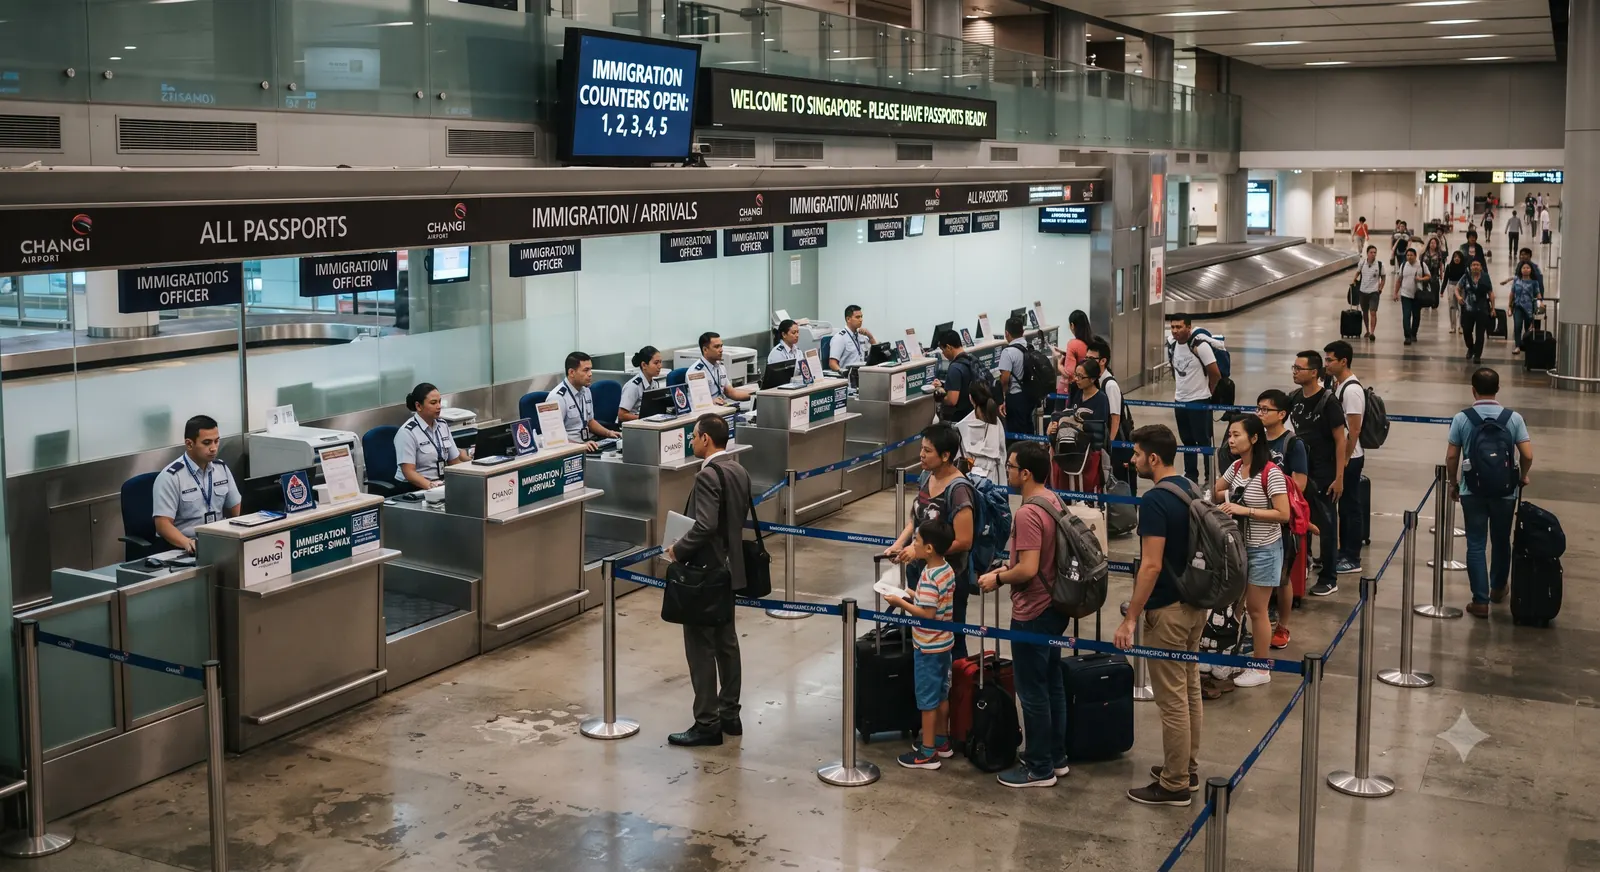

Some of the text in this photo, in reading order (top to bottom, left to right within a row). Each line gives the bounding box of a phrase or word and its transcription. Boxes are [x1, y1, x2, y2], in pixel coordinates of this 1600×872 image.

[592, 59, 683, 87] IMMIGRATION
[580, 84, 689, 112] COUNTERS OPEN:
[731, 88, 788, 113] WELCOME
[790, 94, 804, 114] TO
[807, 95, 861, 118] SINGAPORE
[869, 101, 899, 121] PLEASE
[900, 104, 923, 122] HAVE
[924, 106, 964, 125] PASSPORTS
[601, 113, 668, 138] 1, 2, 3, 4, 5
[790, 193, 899, 215] IMMIGRATION / ARRIVALS
[967, 189, 1009, 204] ALL PASSPORTS
[532, 201, 699, 228] IMMIGRATION / ARRIVALS
[739, 206, 763, 218] CHANGI
[200, 215, 348, 244] ALL PASSPORTS
[427, 221, 466, 233] CHANGI
[20, 238, 91, 254] CHANGI
[680, 247, 703, 258] OFFICER
[740, 242, 762, 253] OFFICER
[21, 254, 60, 264] AIRPORT
[533, 258, 563, 271] OFFICER
[332, 275, 373, 290] OFFICER
[160, 288, 209, 305] OFFICER
[522, 469, 560, 486] IMMIGRATION
[492, 488, 514, 501] CHANGI
[528, 478, 556, 495] ARRIVALS
[251, 552, 283, 567] CHANGI
[292, 543, 324, 560] OFFICER
